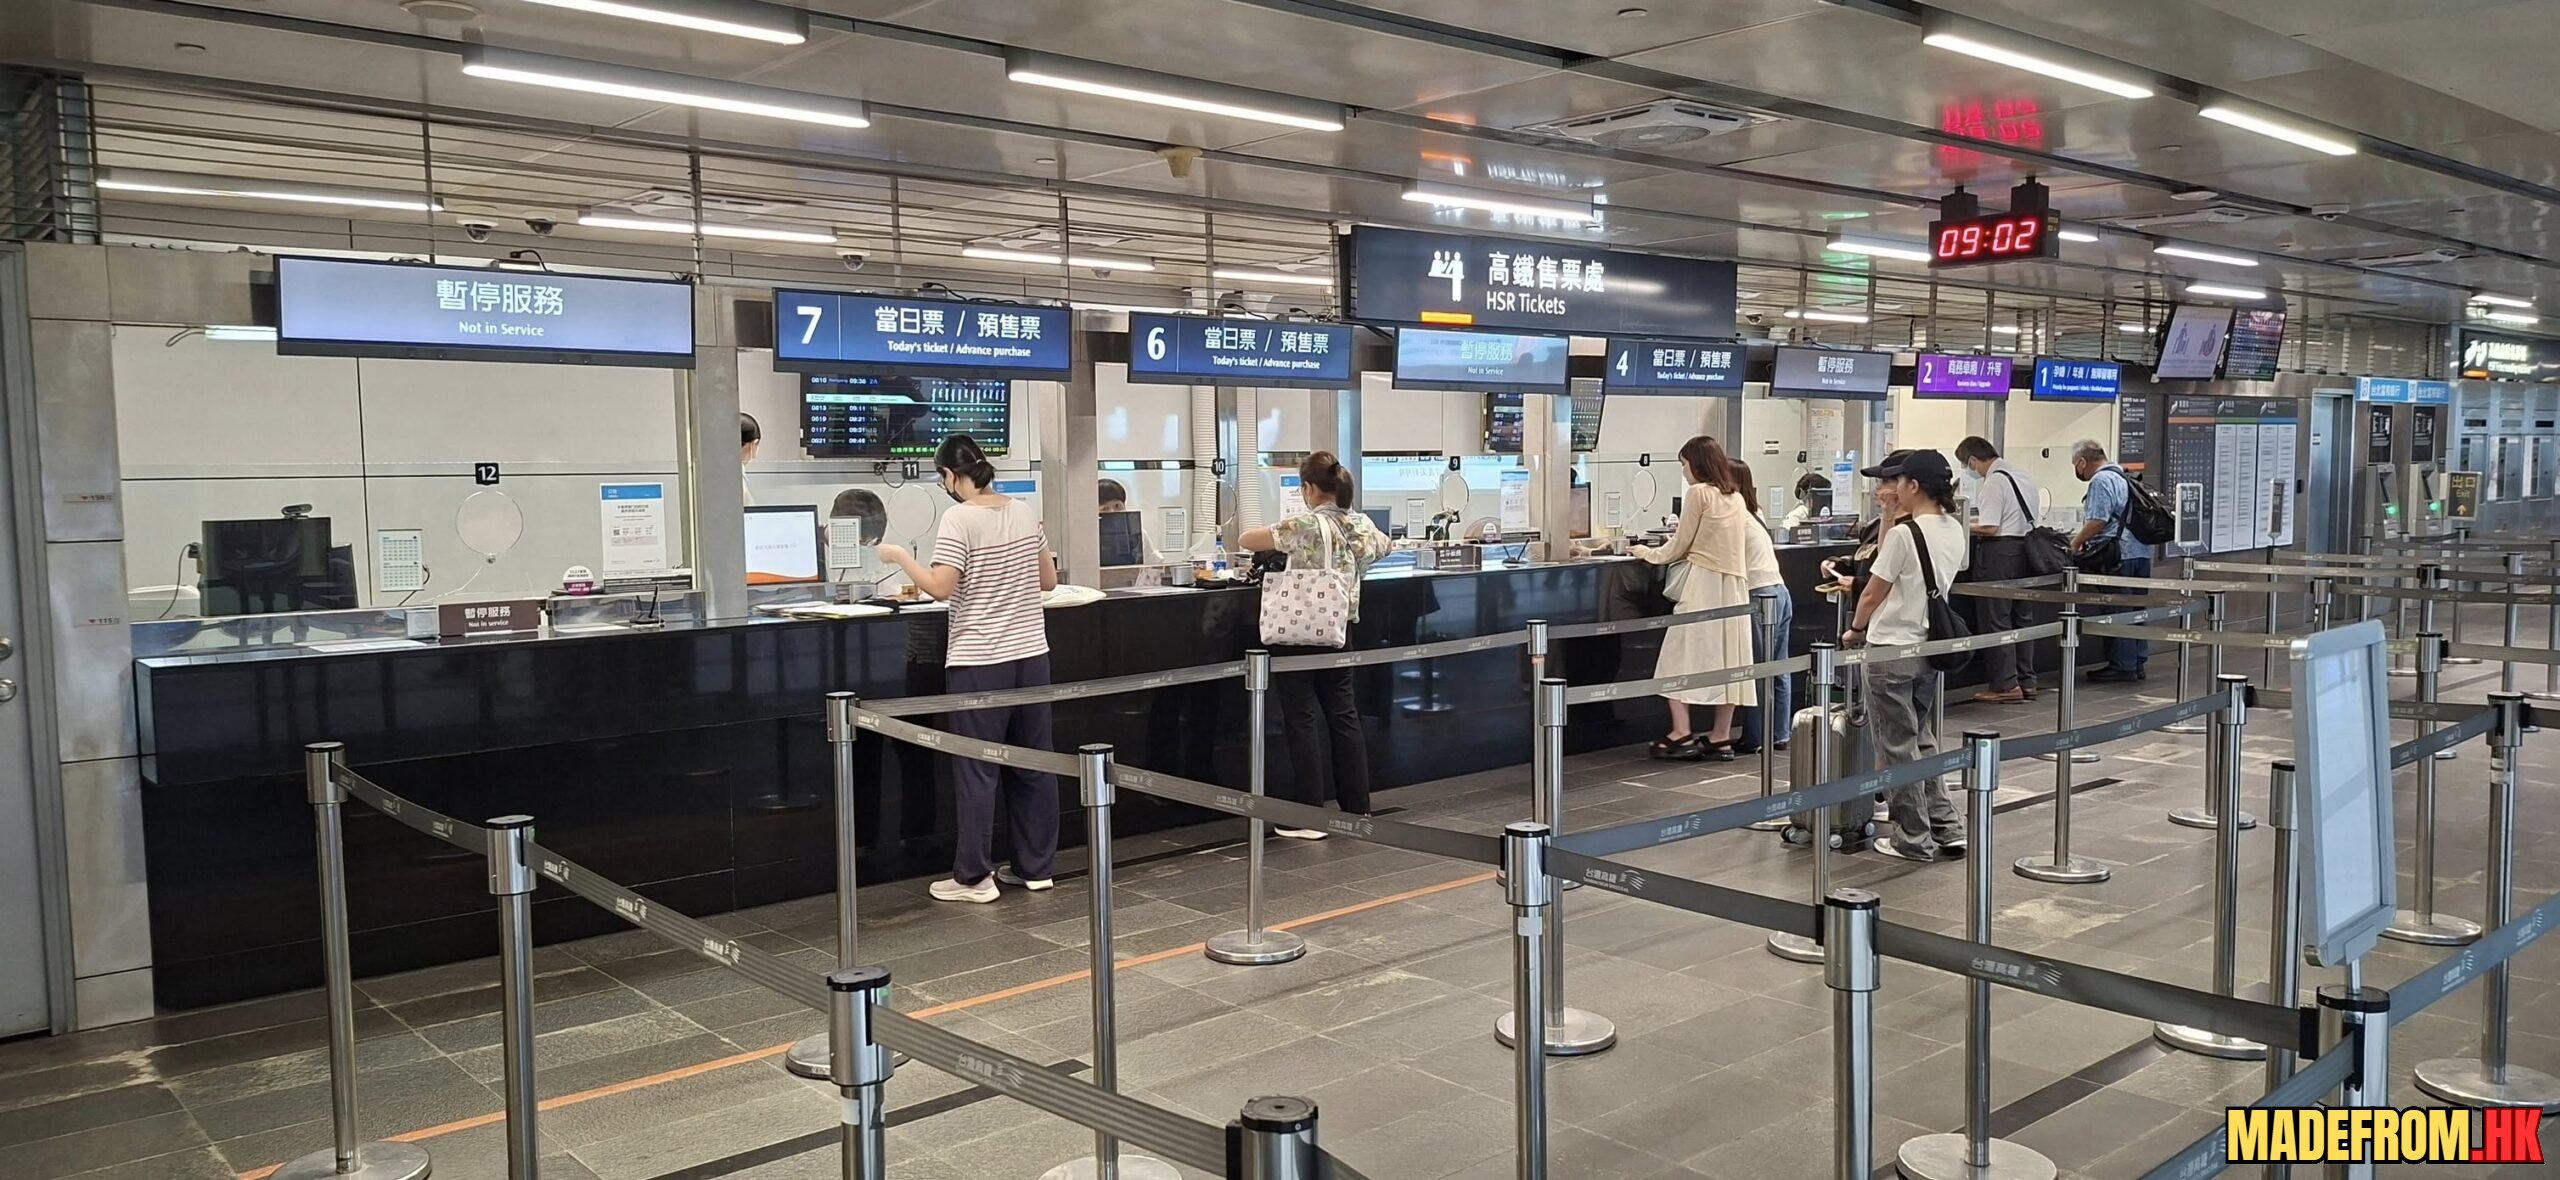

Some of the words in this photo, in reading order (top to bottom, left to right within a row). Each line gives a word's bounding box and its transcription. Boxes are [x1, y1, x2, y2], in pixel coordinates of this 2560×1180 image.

[1938, 220, 2036, 257] 09:02
[1488, 250, 1605, 293] 高鐵售票處
[436, 279, 564, 315] 暫停服務
[1486, 290, 1516, 312] HSR
[1518, 293, 1566, 315] Tickets
[459, 321, 482, 334] Not
[485, 321, 498, 334] in
[501, 323, 545, 336] Service
[796, 306, 822, 344] 7
[875, 306, 944, 335] 當日票
[956, 310, 966, 337] /
[977, 312, 1041, 340] 預售票
[887, 340, 922, 354] Today's
[922, 342, 949, 354] ticket
[955, 343, 992, 356] Advance
[993, 346, 1031, 358] purchase
[1147, 326, 1166, 360] 6
[1205, 326, 1256, 351] 當日票
[1264, 329, 1273, 352] /
[1280, 330, 1329, 354] 預售票
[1461, 341, 1513, 362] 暫停服務
[1653, 348, 1686, 367] 當日票
[1689, 349, 1697, 368] /
[1700, 351, 1732, 369] 預售票
[1212, 355, 1239, 367] Today's
[1239, 356, 1258, 367] ticket
[1263, 358, 1290, 368] Advance
[1291, 359, 1320, 369] purchase
[1468, 366, 1477, 374] Not
[1478, 366, 1484, 374] in
[1485, 367, 1504, 376] Service
[1616, 350, 1629, 376] 4
[1818, 356, 1854, 374] 暫停服務
[1922, 361, 1932, 384] 2
[2041, 367, 2048, 387] 1
[904, 464, 917, 477] 11
[1214, 461, 1225, 471] 10
[1452, 458, 1458, 468] 9
[478, 466, 497, 481] 12
[2452, 475, 2476, 488] 出口
[465, 606, 511, 619] 暫停服務
